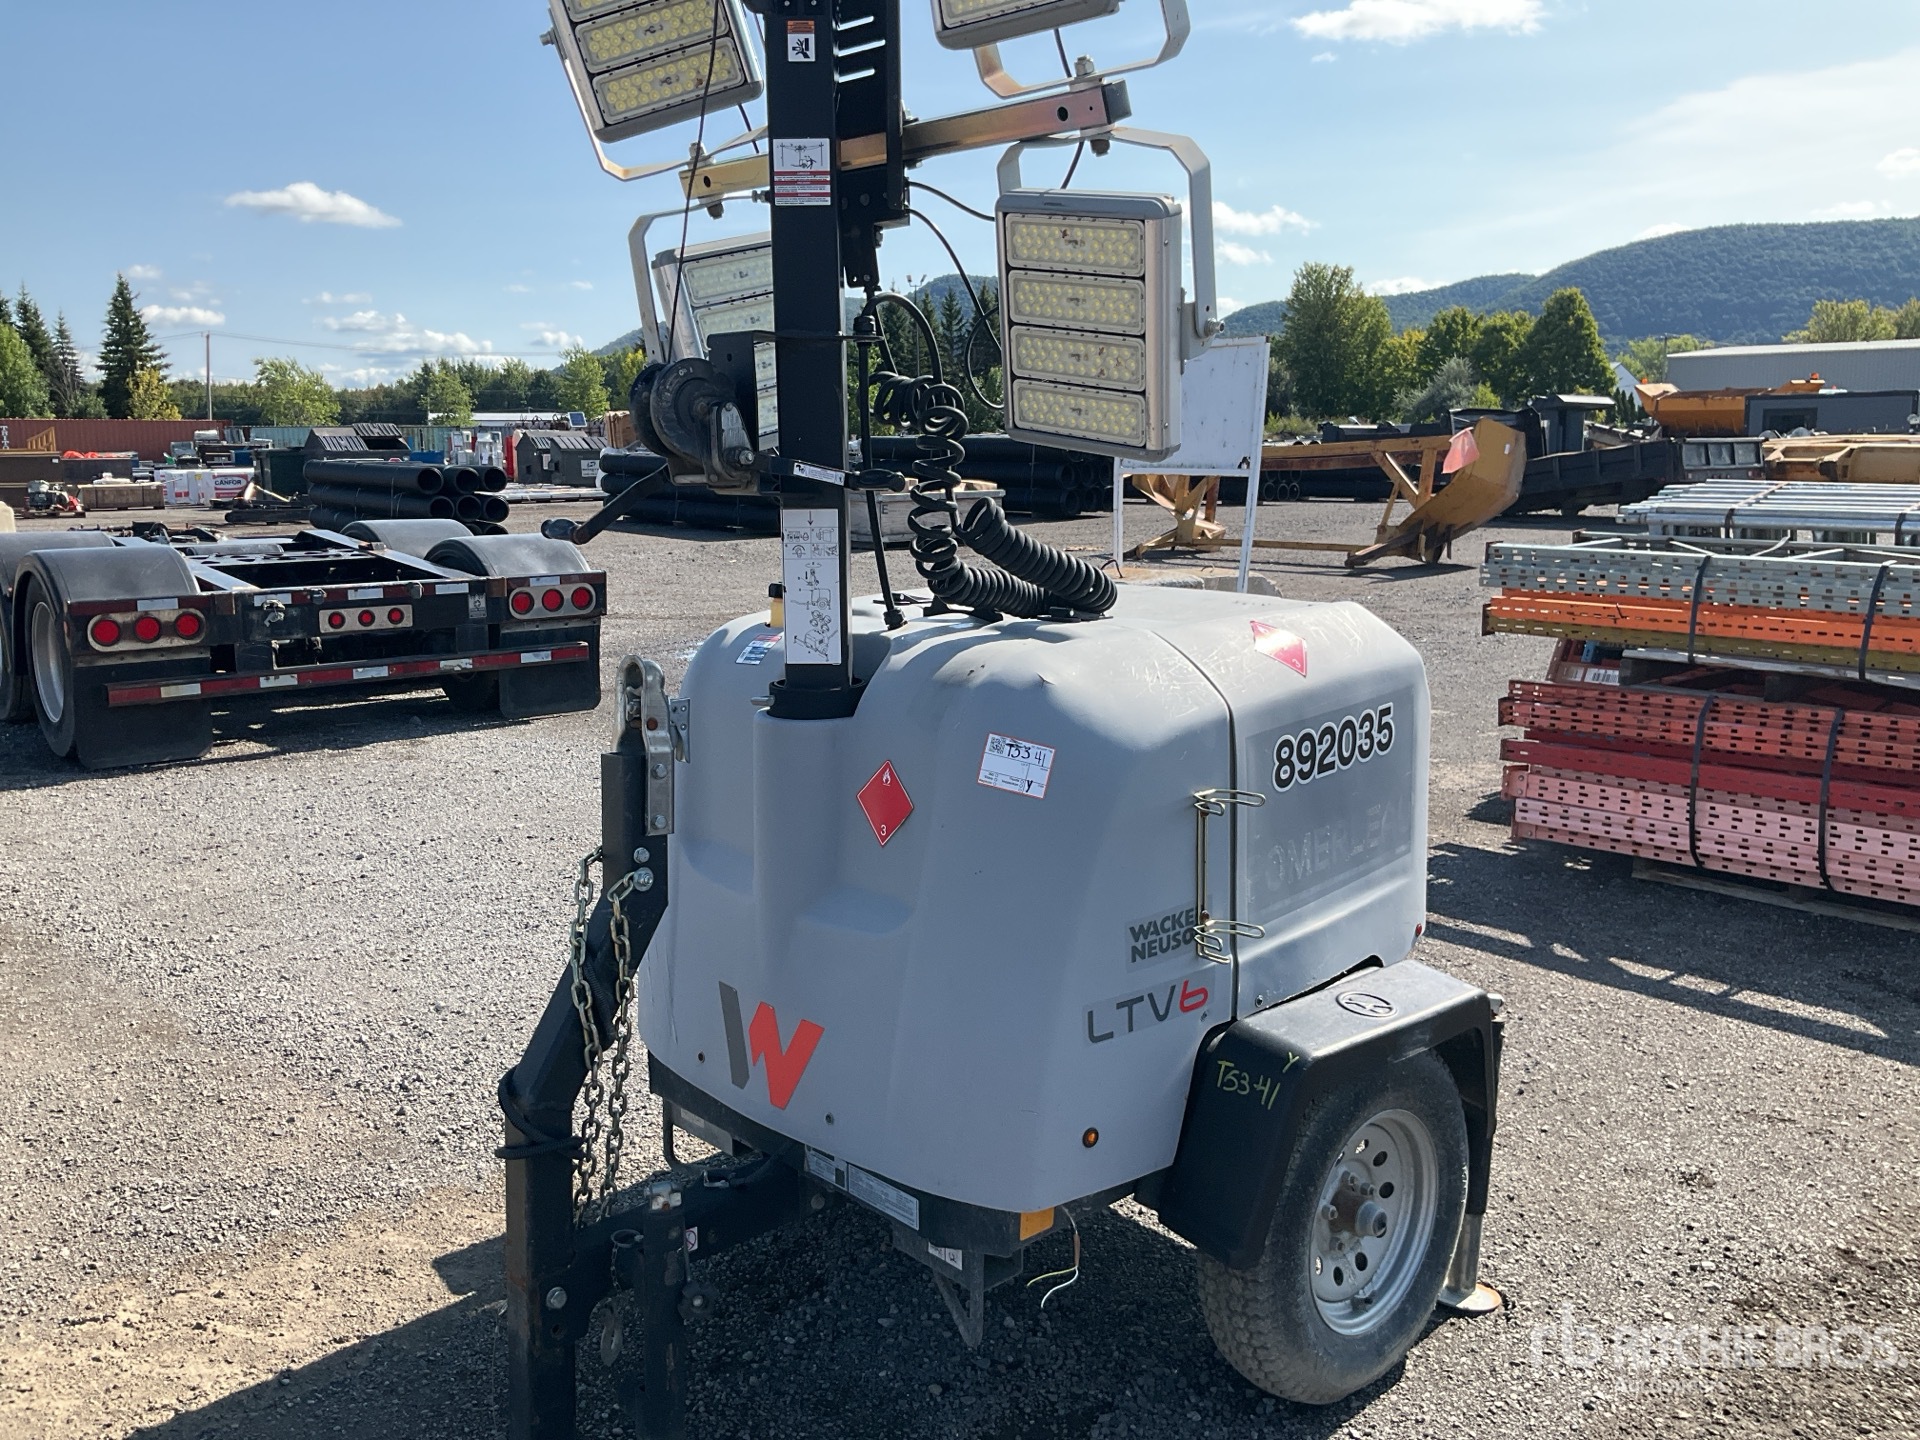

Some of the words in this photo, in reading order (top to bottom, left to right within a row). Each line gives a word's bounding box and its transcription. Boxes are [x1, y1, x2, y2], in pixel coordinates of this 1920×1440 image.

[1273, 702, 1394, 792] 892035
[880, 824, 887, 836] 3
[1129, 907, 1196, 943] WACKE
[1131, 926, 1196, 963] NEUSO
